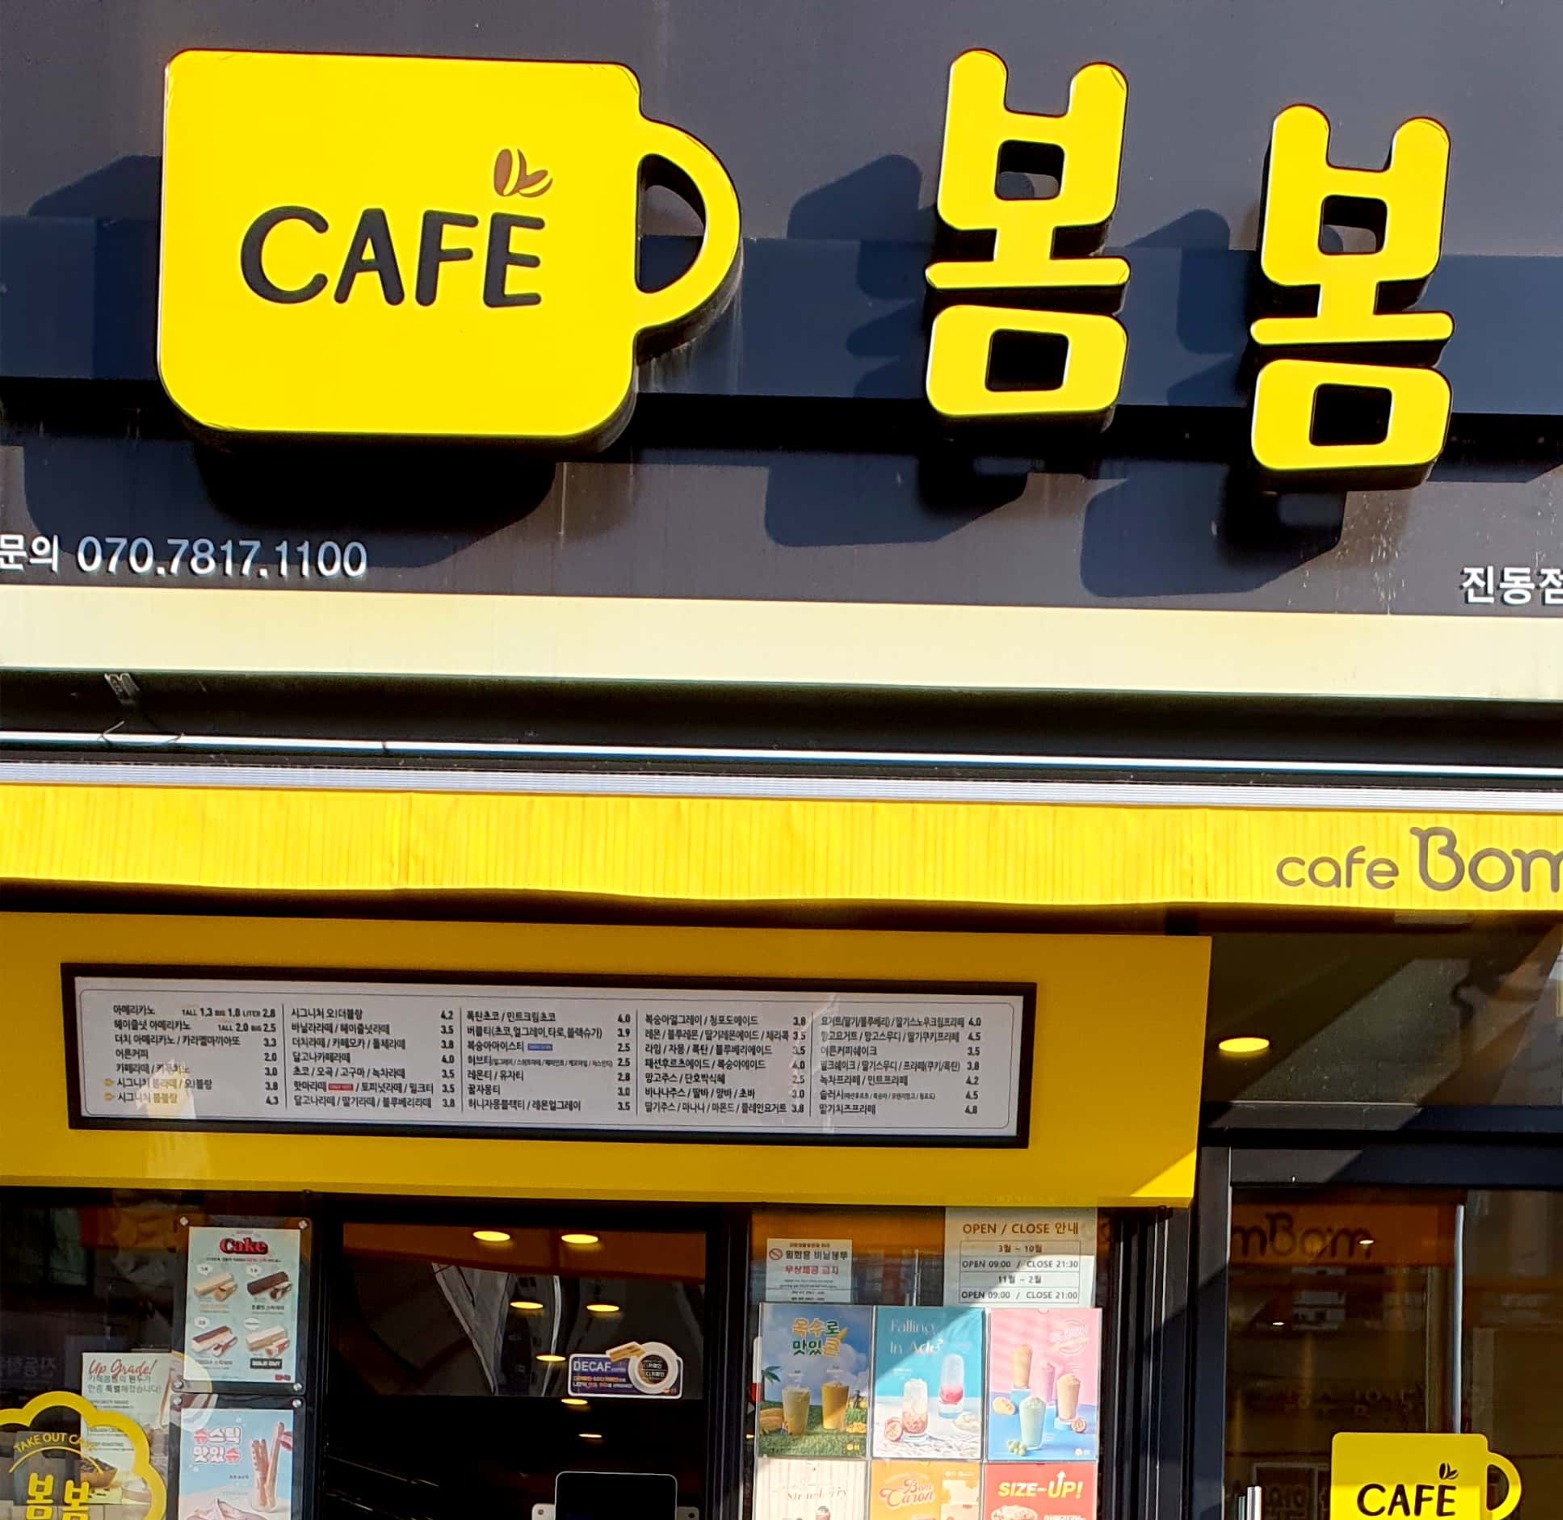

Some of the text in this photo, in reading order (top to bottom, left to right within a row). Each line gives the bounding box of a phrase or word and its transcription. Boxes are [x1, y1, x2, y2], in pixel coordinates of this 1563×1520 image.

[241, 204, 543, 309] CAFE
[0, 534, 369, 578] 문의 070.7817.1100
[1462, 565, 1563, 606] 진동점
[1277, 826, 1563, 893] cafe Bom
[114, 1005, 212, 1017] 아메리카노 1.3
[292, 1008, 453, 1020] 시그니처 4.2
[507, 1012, 630, 1023] 민트크림초코 4.0
[645, 1015, 758, 1026] 복숭아얼그레이 청포도에이드
[969, 1017, 981, 1026] 4.0
[114, 1019, 276, 1032] 헤이즐넛 아메리카노 2.0 2.5
[292, 1023, 453, 1034] 바닐라라떼 헤이즐넛라떼 3.5
[618, 1029, 630, 1037] 3.9
[645, 1030, 759, 1041] 레몬 블루레몬 딸기레몬에이드
[822, 1031, 981, 1042] 망고요거트 망고스무디 4.5
[134, 1035, 277, 1047] 아메리카노 3.3
[292, 1038, 453, 1049] 더치라떼 3.8
[467, 1041, 524, 1051] 복숭아아이스티
[618, 1043, 630, 1052] 2.5
[645, 1044, 772, 1055] 라임 자몽 블루베리에이드
[967, 1047, 980, 1056] 3.5
[264, 1053, 277, 1062] 2.0
[293, 1052, 454, 1063] 달고나카페라떼 4.0
[618, 1058, 630, 1066] 2.5
[116, 1063, 277, 1076] 카페라떼 3.0
[645, 1059, 805, 1070] 패션후르츠에이드 복숭아에이드 4.0
[862, 1061, 979, 1071] 딸기스무디 3.8
[293, 1067, 454, 1079] 초코 오곡 고구마 녹차라떼 3.5
[468, 1070, 630, 1081] 레몬티 유자티 2.8
[645, 1073, 805, 1084] 망고주스 단호박식혜 2.5
[820, 1075, 979, 1086] 녹차프라페 민트프라페 4.2
[362, 1082, 402, 1093] 토피넛라떼
[410, 1083, 433, 1094] 밀크티
[442, 1084, 455, 1093] 3.5
[468, 1084, 630, 1096] 꿀자몽티 3.0
[645, 1088, 804, 1098] 바나나주스 딸바 3.0
[966, 1091, 978, 1100] 4.5
[294, 1096, 431, 1108] 달고나라떼 딸기라떼 블루베리라떼
[469, 1100, 630, 1111] 허니자몽블랙티 레몬얼그레이 3.5
[645, 1102, 786, 1114] 딸기주스 플레인요거트
[819, 1104, 876, 1115] 딸기치즈프라페
[963, 1222, 1078, 1235] OPEN CLOSE 안내
[219, 1237, 268, 1255] Cake
[998, 1244, 1042, 1253] 3월 10월
[988, 1260, 1011, 1268] 09:00
[1026, 1260, 1052, 1268] CLOSE
[1056, 1260, 1078, 1268] 21:30
[998, 1276, 1041, 1284] 11월 2월
[889, 1319, 937, 1336] Falling
[89, 1359, 158, 1379] Up Grade!
[573, 1361, 612, 1372] DECAF
[14, 1435, 41, 1453] TAKE
[43, 1432, 67, 1444] OUT
[997, 1480, 1083, 1499] SIZE-UP!
[1357, 1483, 1457, 1517] CAFE
